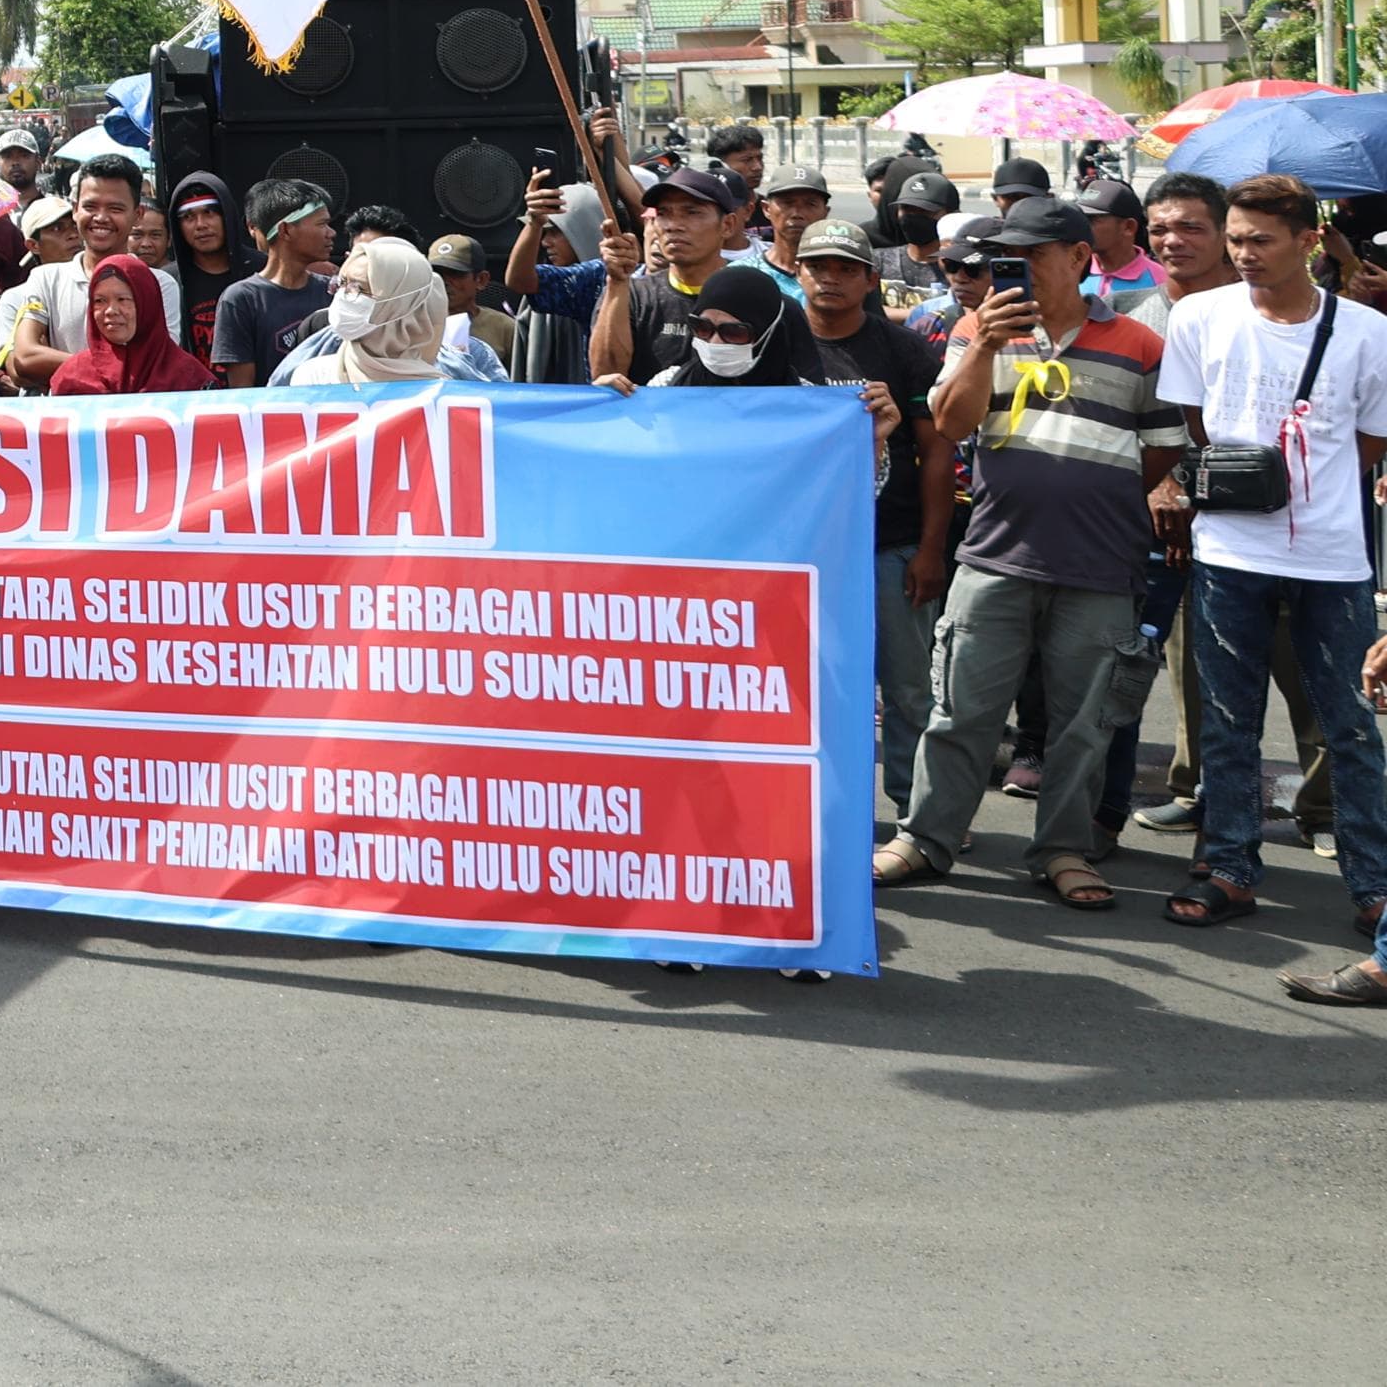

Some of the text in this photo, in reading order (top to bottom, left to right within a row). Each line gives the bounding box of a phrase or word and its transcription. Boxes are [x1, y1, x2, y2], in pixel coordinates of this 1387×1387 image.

[104, 405, 485, 538] DAMAI
[83, 578, 228, 628] SELIDIK
[237, 582, 341, 631] USUT
[350, 585, 551, 638] BERBAGAI
[562, 591, 755, 649] INDIKASI
[23, 635, 137, 684] DINAS
[146, 639, 359, 692] KESEHATAN
[368, 645, 473, 696] HULU
[483, 649, 645, 706] SUNGAI
[654, 659, 791, 714] UTARA
[93, 754, 221, 808] SELIDIKI
[227, 763, 308, 813] USUT
[313, 767, 478, 825] BERBAGAI
[486, 779, 642, 836] INDIKASI
[51, 811, 139, 863] SAKIT
[147, 818, 306, 875] PEMBALAH
[314, 828, 445, 887] BATUNG
[452, 839, 542, 894] HULU
[548, 845, 676, 902] SUNGAI
[685, 854, 794, 910] UTARA
